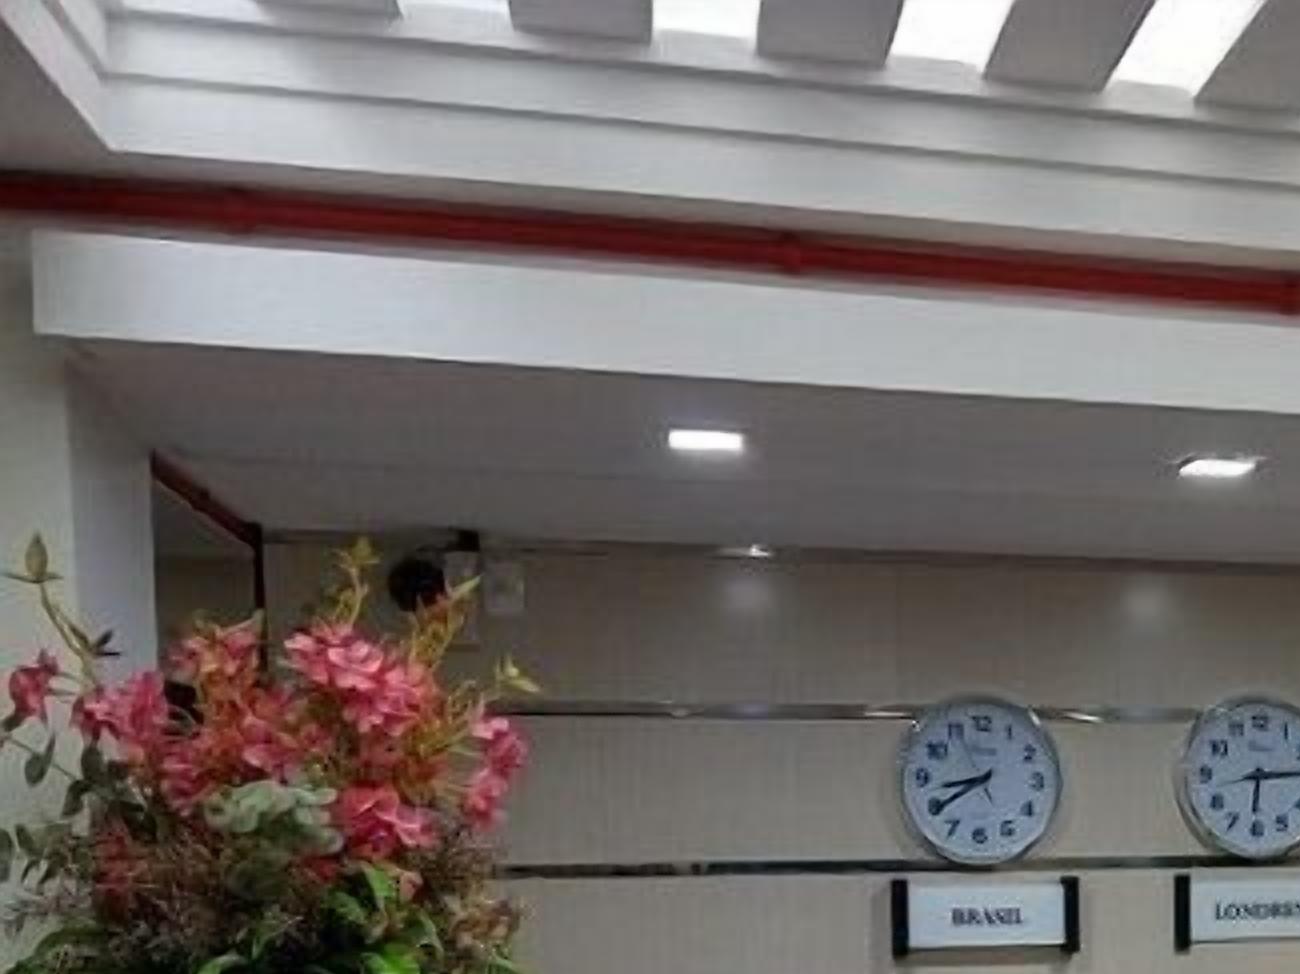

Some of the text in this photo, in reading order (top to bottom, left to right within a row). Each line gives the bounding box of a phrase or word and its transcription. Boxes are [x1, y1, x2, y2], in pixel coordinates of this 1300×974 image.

[915, 768, 930, 788] 9
[1029, 772, 1045, 791] 3
[944, 819, 961, 839] 7
[1224, 812, 1241, 833] 7
[1275, 814, 1289, 832] 5
[951, 907, 1023, 926] BRASIL
